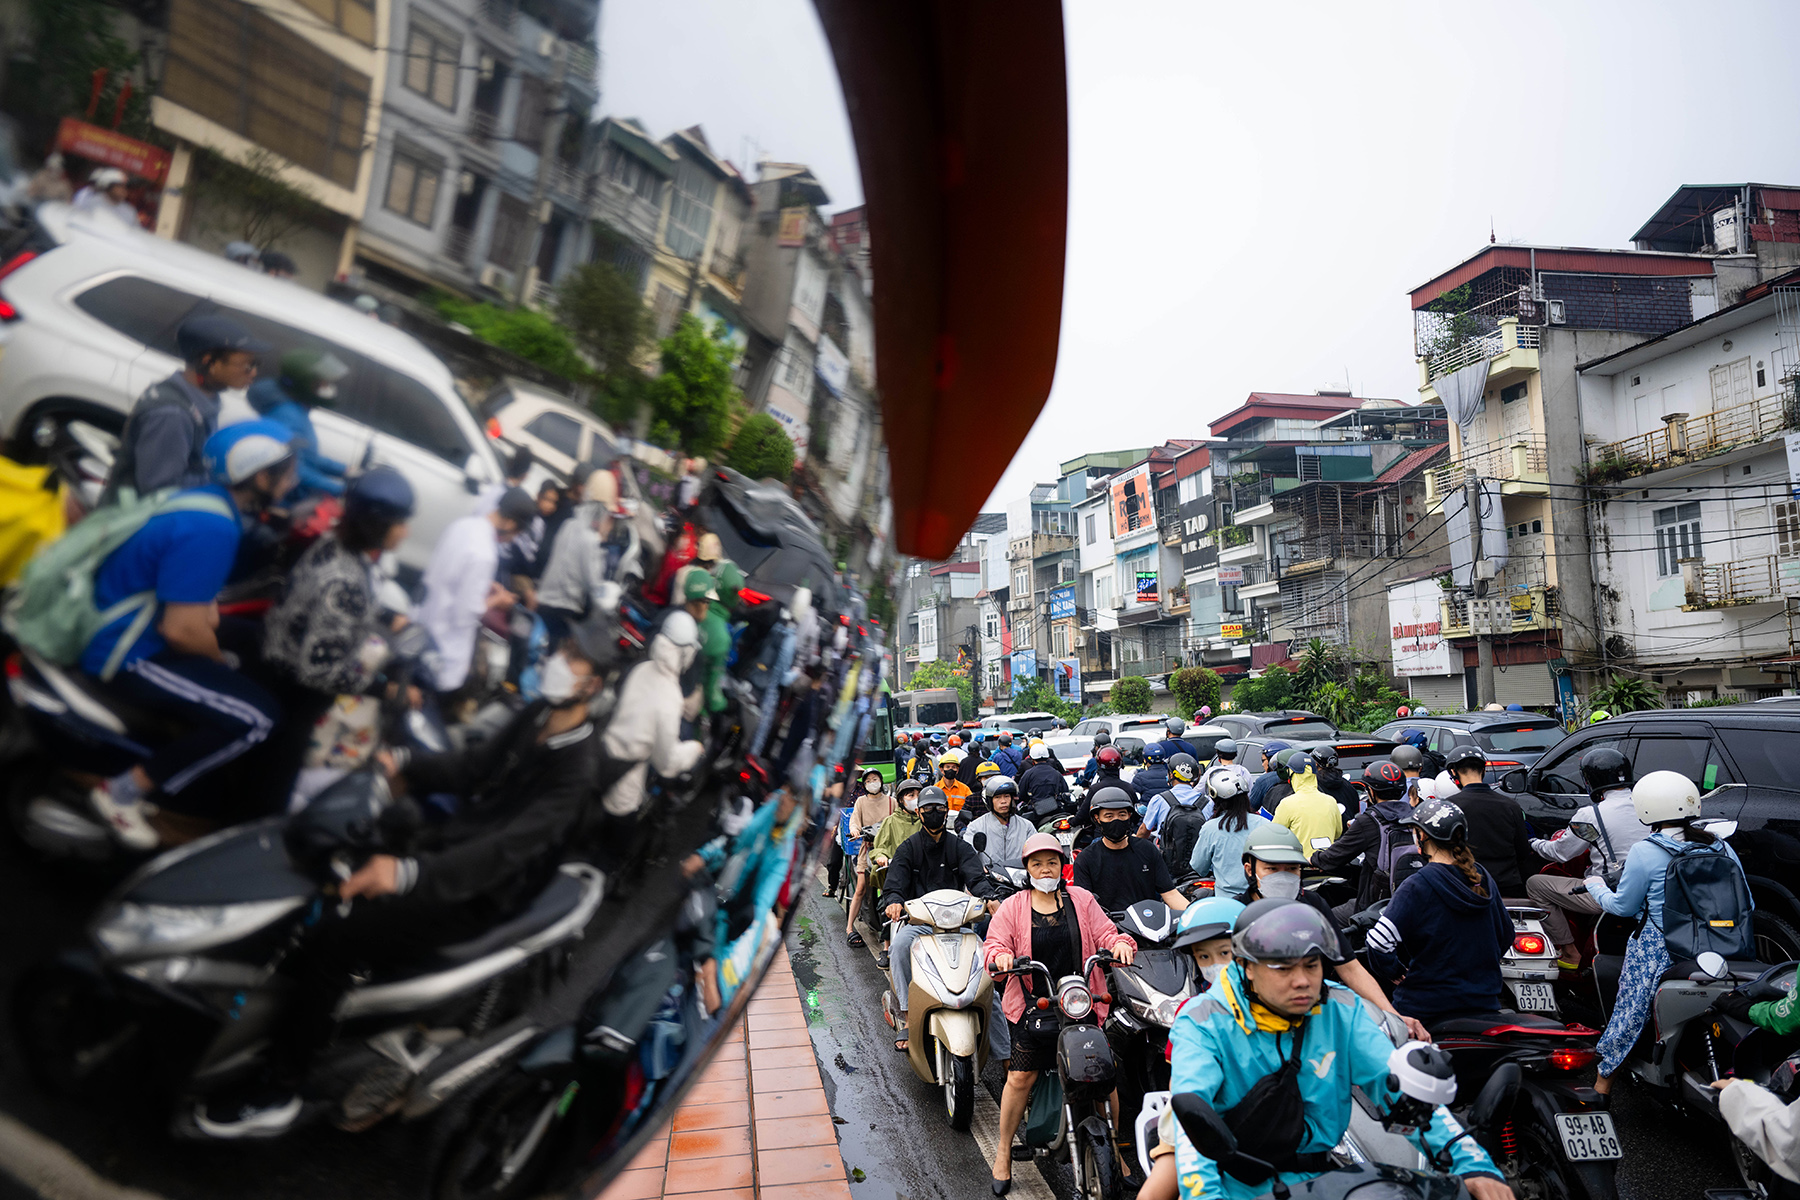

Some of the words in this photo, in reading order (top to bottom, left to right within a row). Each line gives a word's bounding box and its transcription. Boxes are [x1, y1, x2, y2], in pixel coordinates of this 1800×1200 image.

[1119, 491, 1147, 518] RM
[1183, 514, 1209, 536] TAD
[1392, 622, 1404, 639] HÀ
[1519, 984, 1548, 997] 29-B1
[1519, 997, 1554, 1010] 037.74
[1564, 1115, 1607, 1136] 99-AB
[1567, 1137, 1619, 1158] 034.69
